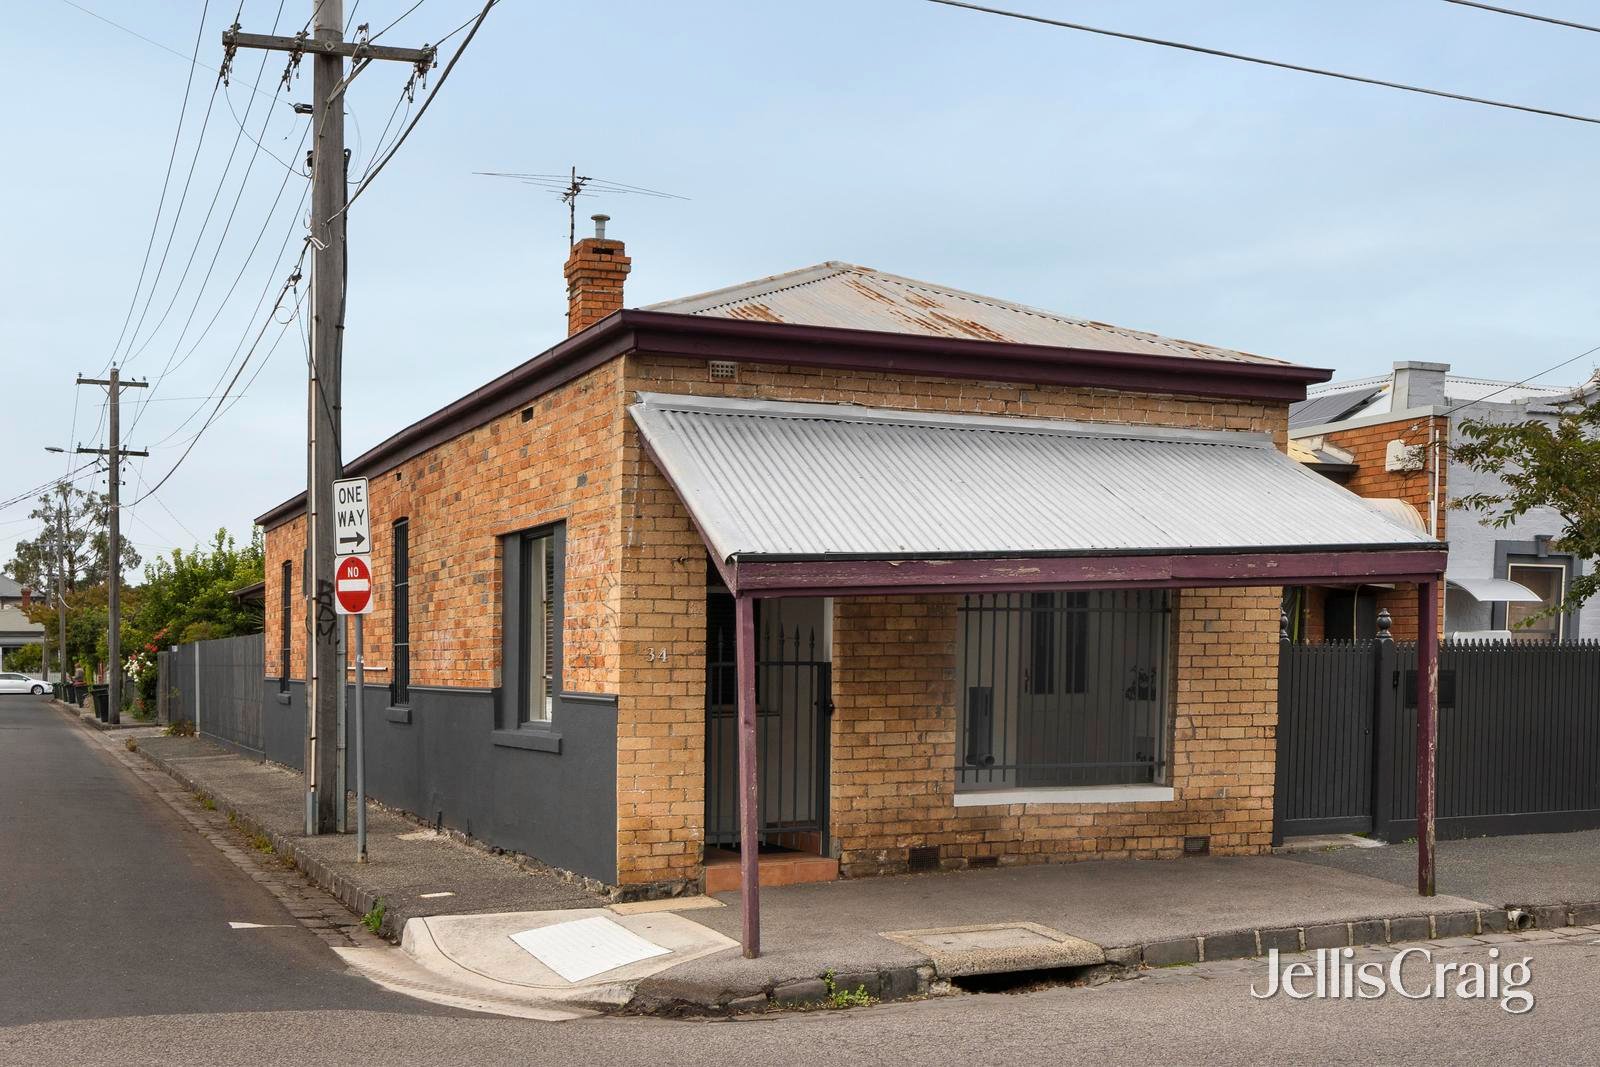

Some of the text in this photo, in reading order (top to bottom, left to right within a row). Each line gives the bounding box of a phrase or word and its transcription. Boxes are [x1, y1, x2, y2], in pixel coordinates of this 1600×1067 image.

[339, 486, 363, 504] ONE
[338, 509, 365, 527] WAY
[347, 567, 360, 578] NO
[647, 647, 668, 663] 34
